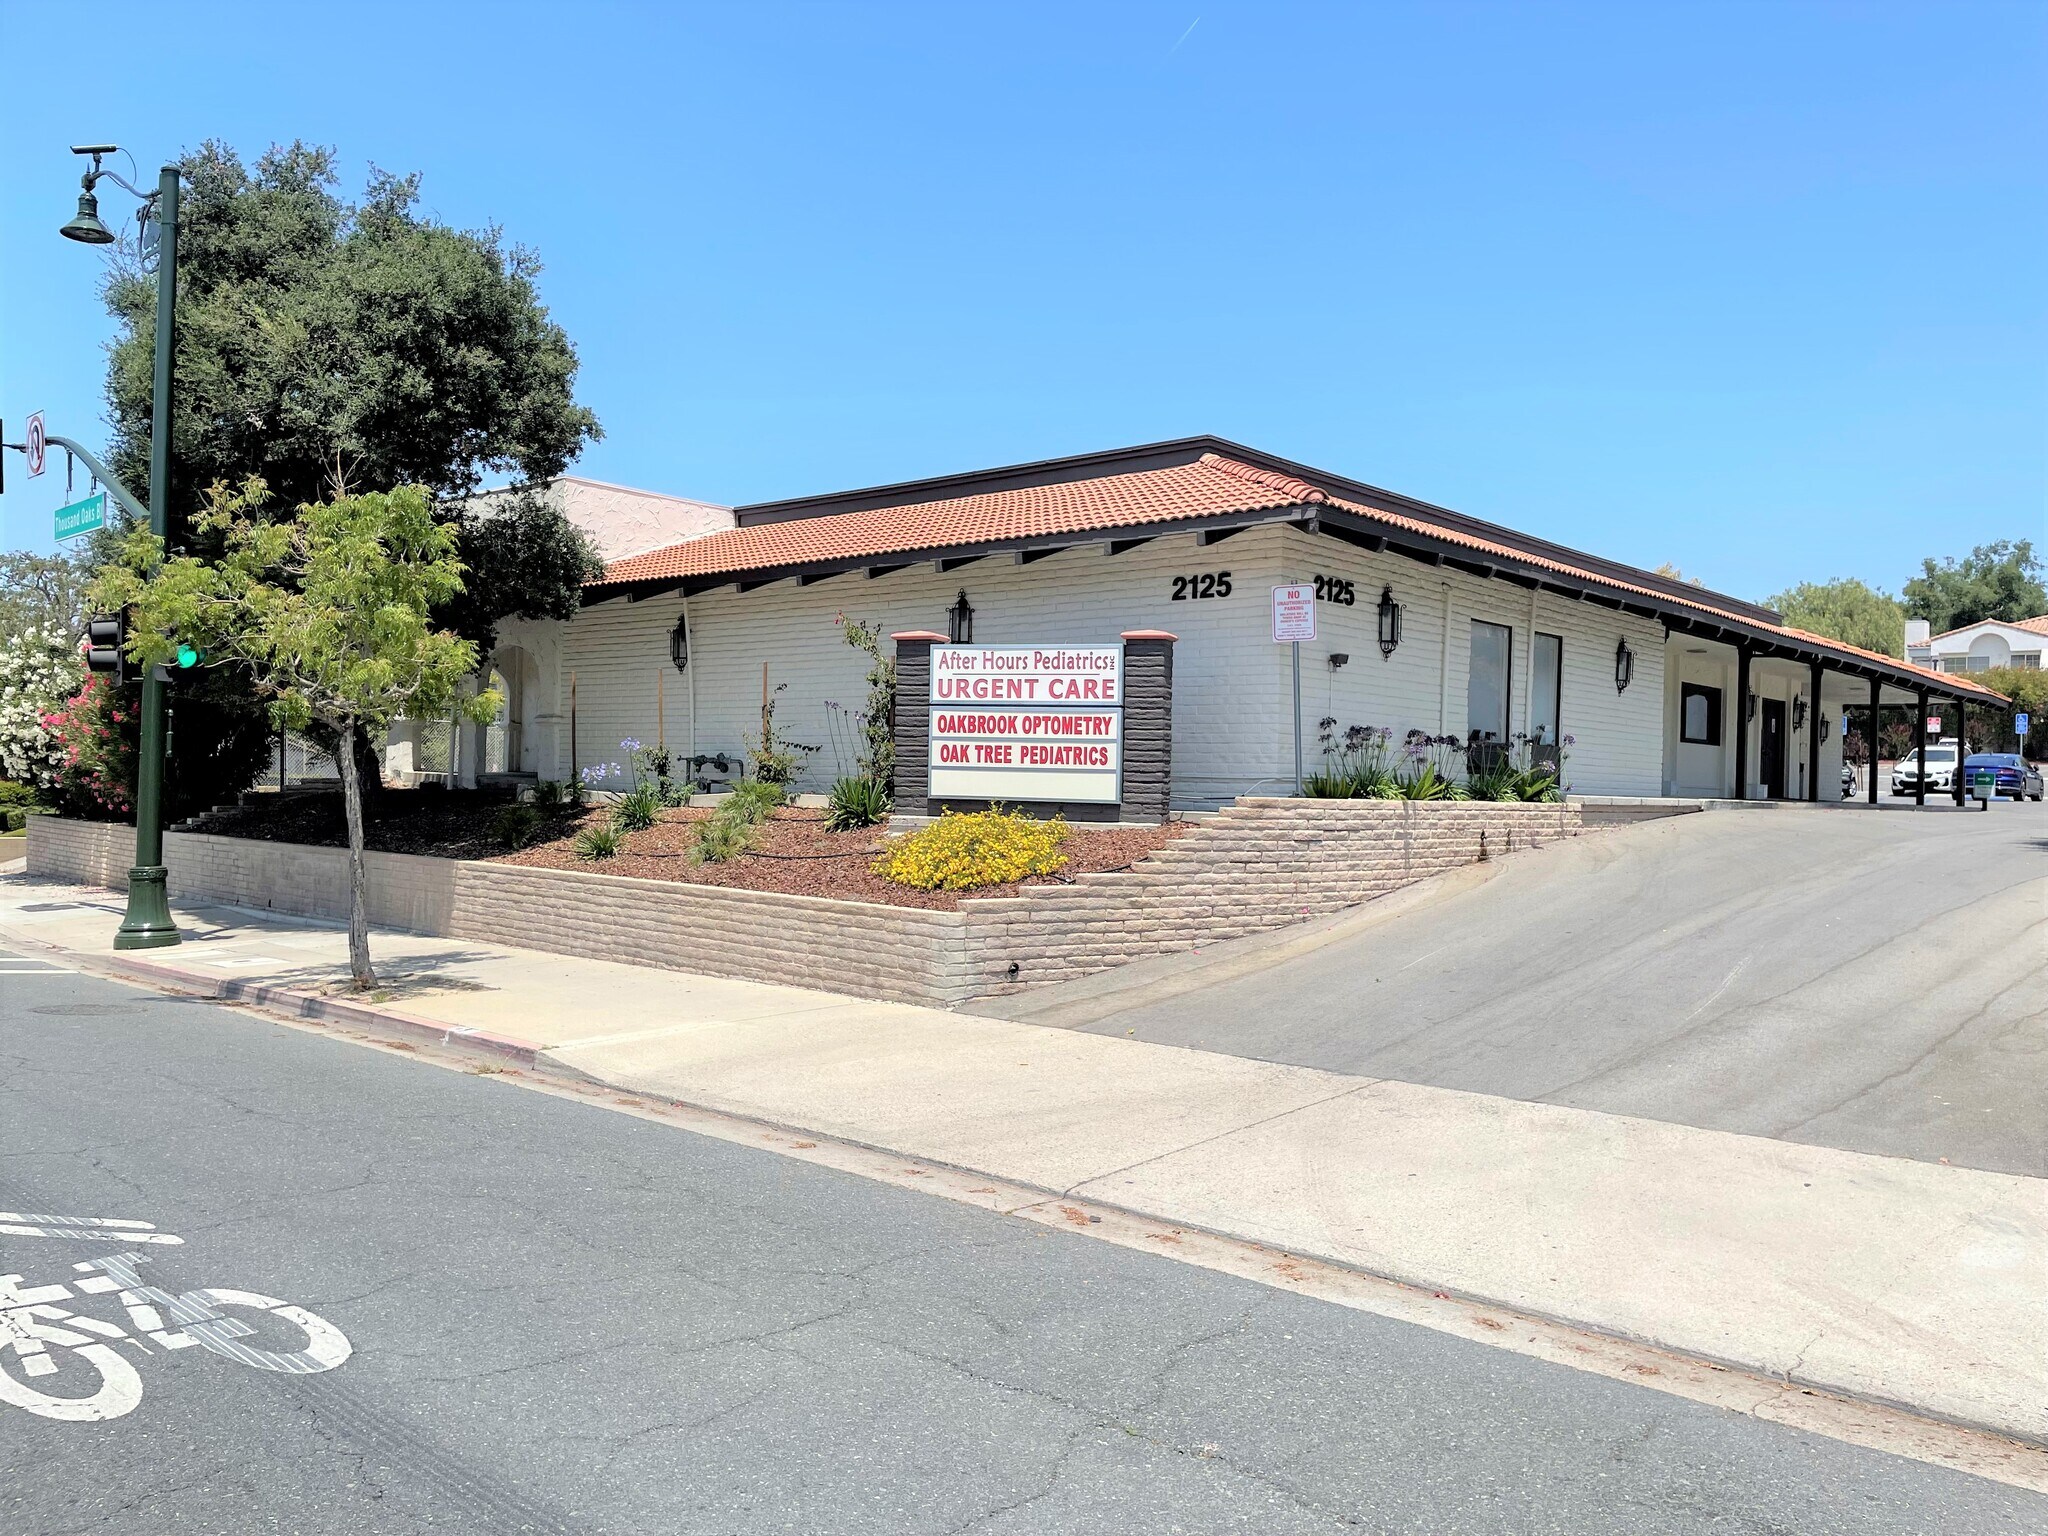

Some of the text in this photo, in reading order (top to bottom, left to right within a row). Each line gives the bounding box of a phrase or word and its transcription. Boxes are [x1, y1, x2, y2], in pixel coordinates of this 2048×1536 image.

[56, 510, 80, 532] Thousand
[81, 507, 94, 524] Oaks
[1172, 571, 1232, 601] 2125
[1287, 590, 1300, 599] NO
[1315, 575, 1355, 606] 2125
[938, 651, 1109, 670] After Hours Pediatrics
[938, 678, 1115, 699] URGENT CARE
[937, 714, 1113, 736] OAKBROOK OPTOMETRY
[940, 743, 1109, 766] OAK TREE PEDIATRICS
